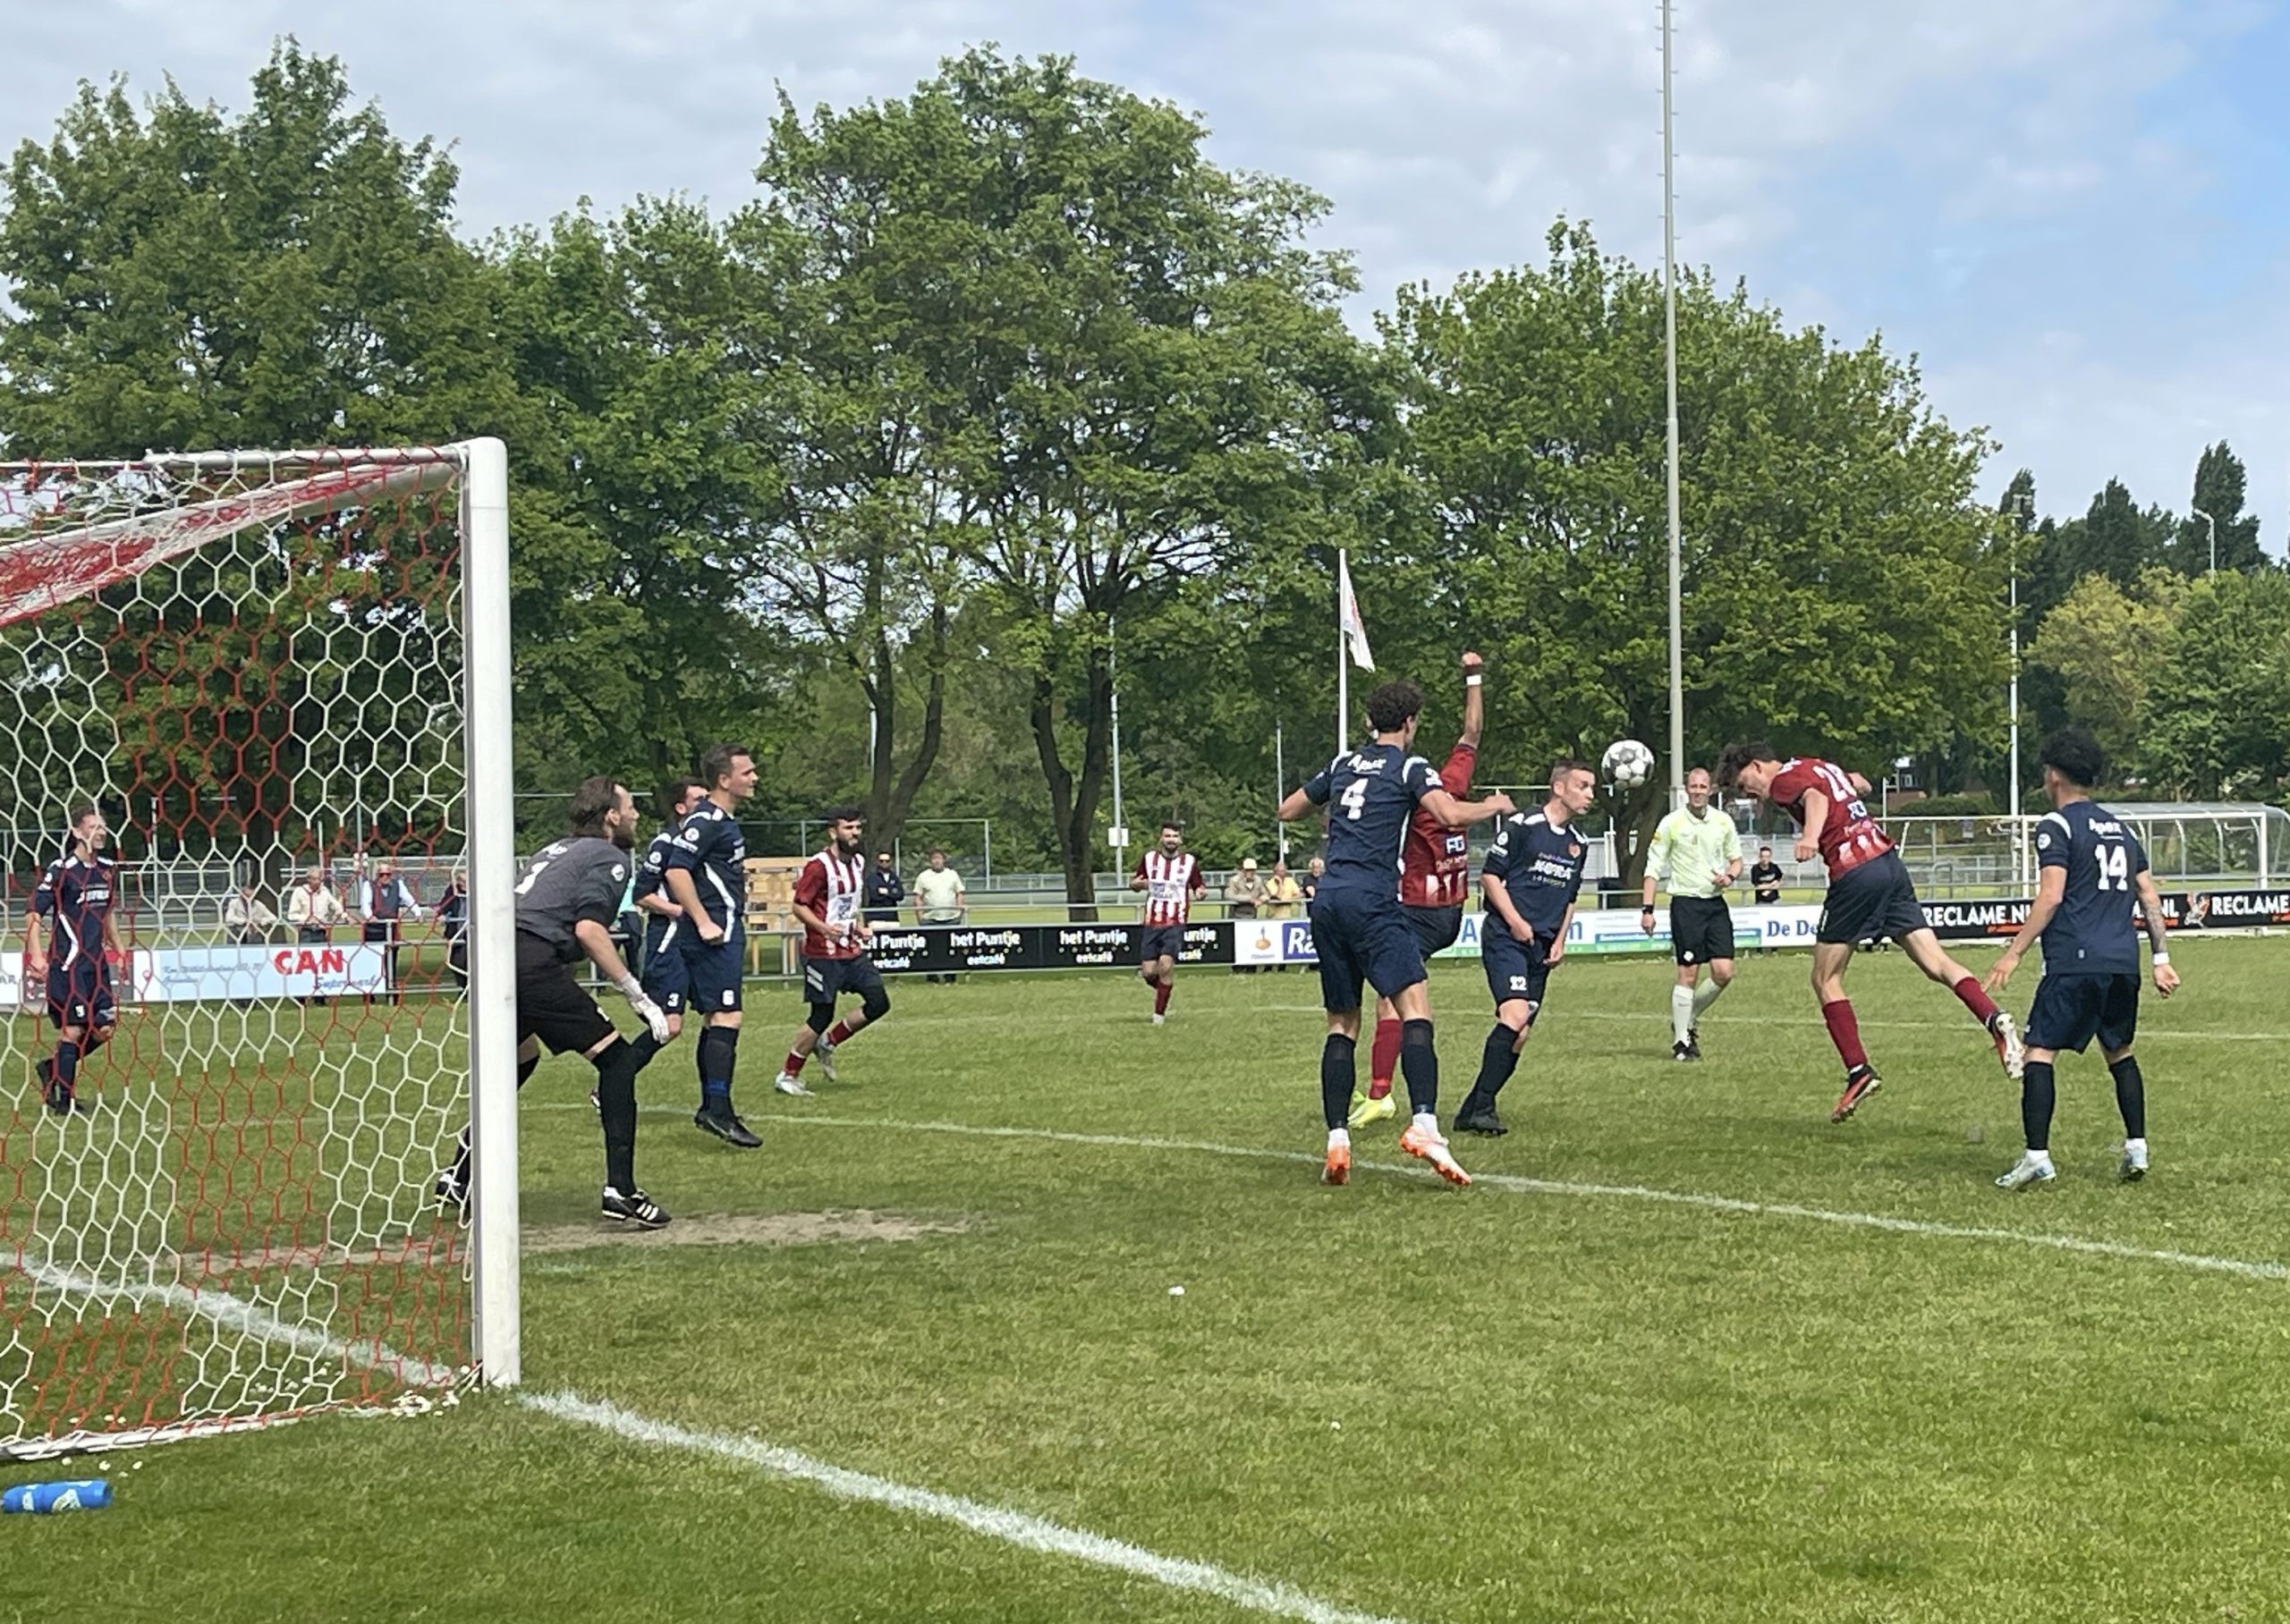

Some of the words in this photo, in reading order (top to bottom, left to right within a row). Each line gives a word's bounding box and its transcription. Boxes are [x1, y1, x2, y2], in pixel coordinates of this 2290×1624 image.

[1340, 778, 1369, 820] 4
[2094, 843, 2128, 892] 14
[1059, 930, 1082, 945] het
[1084, 928, 1128, 946] Puntje
[1183, 926, 1217, 943] untje
[1767, 919, 1791, 937] De
[880, 933, 927, 951] Puntje
[950, 932, 973, 947] het
[976, 930, 1021, 948] Puntje
[274, 950, 344, 976] CAN
